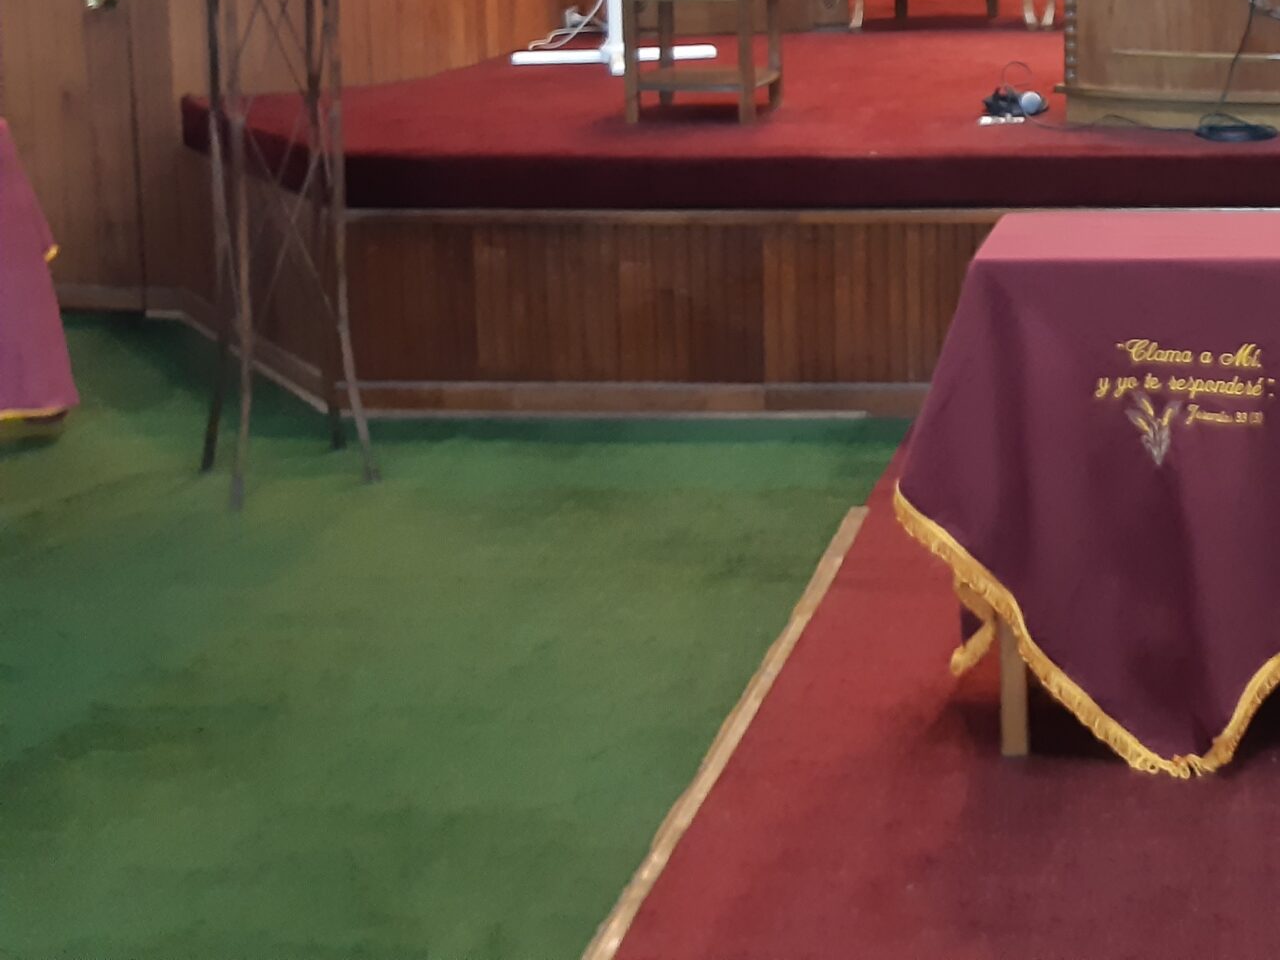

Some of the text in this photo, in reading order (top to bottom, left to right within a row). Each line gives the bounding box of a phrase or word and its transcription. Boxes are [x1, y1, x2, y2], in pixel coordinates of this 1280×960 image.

[1200, 351, 1213, 363] a
[1095, 376, 1110, 398] y
[1114, 376, 1138, 398] yo
[1144, 373, 1161, 389] te
